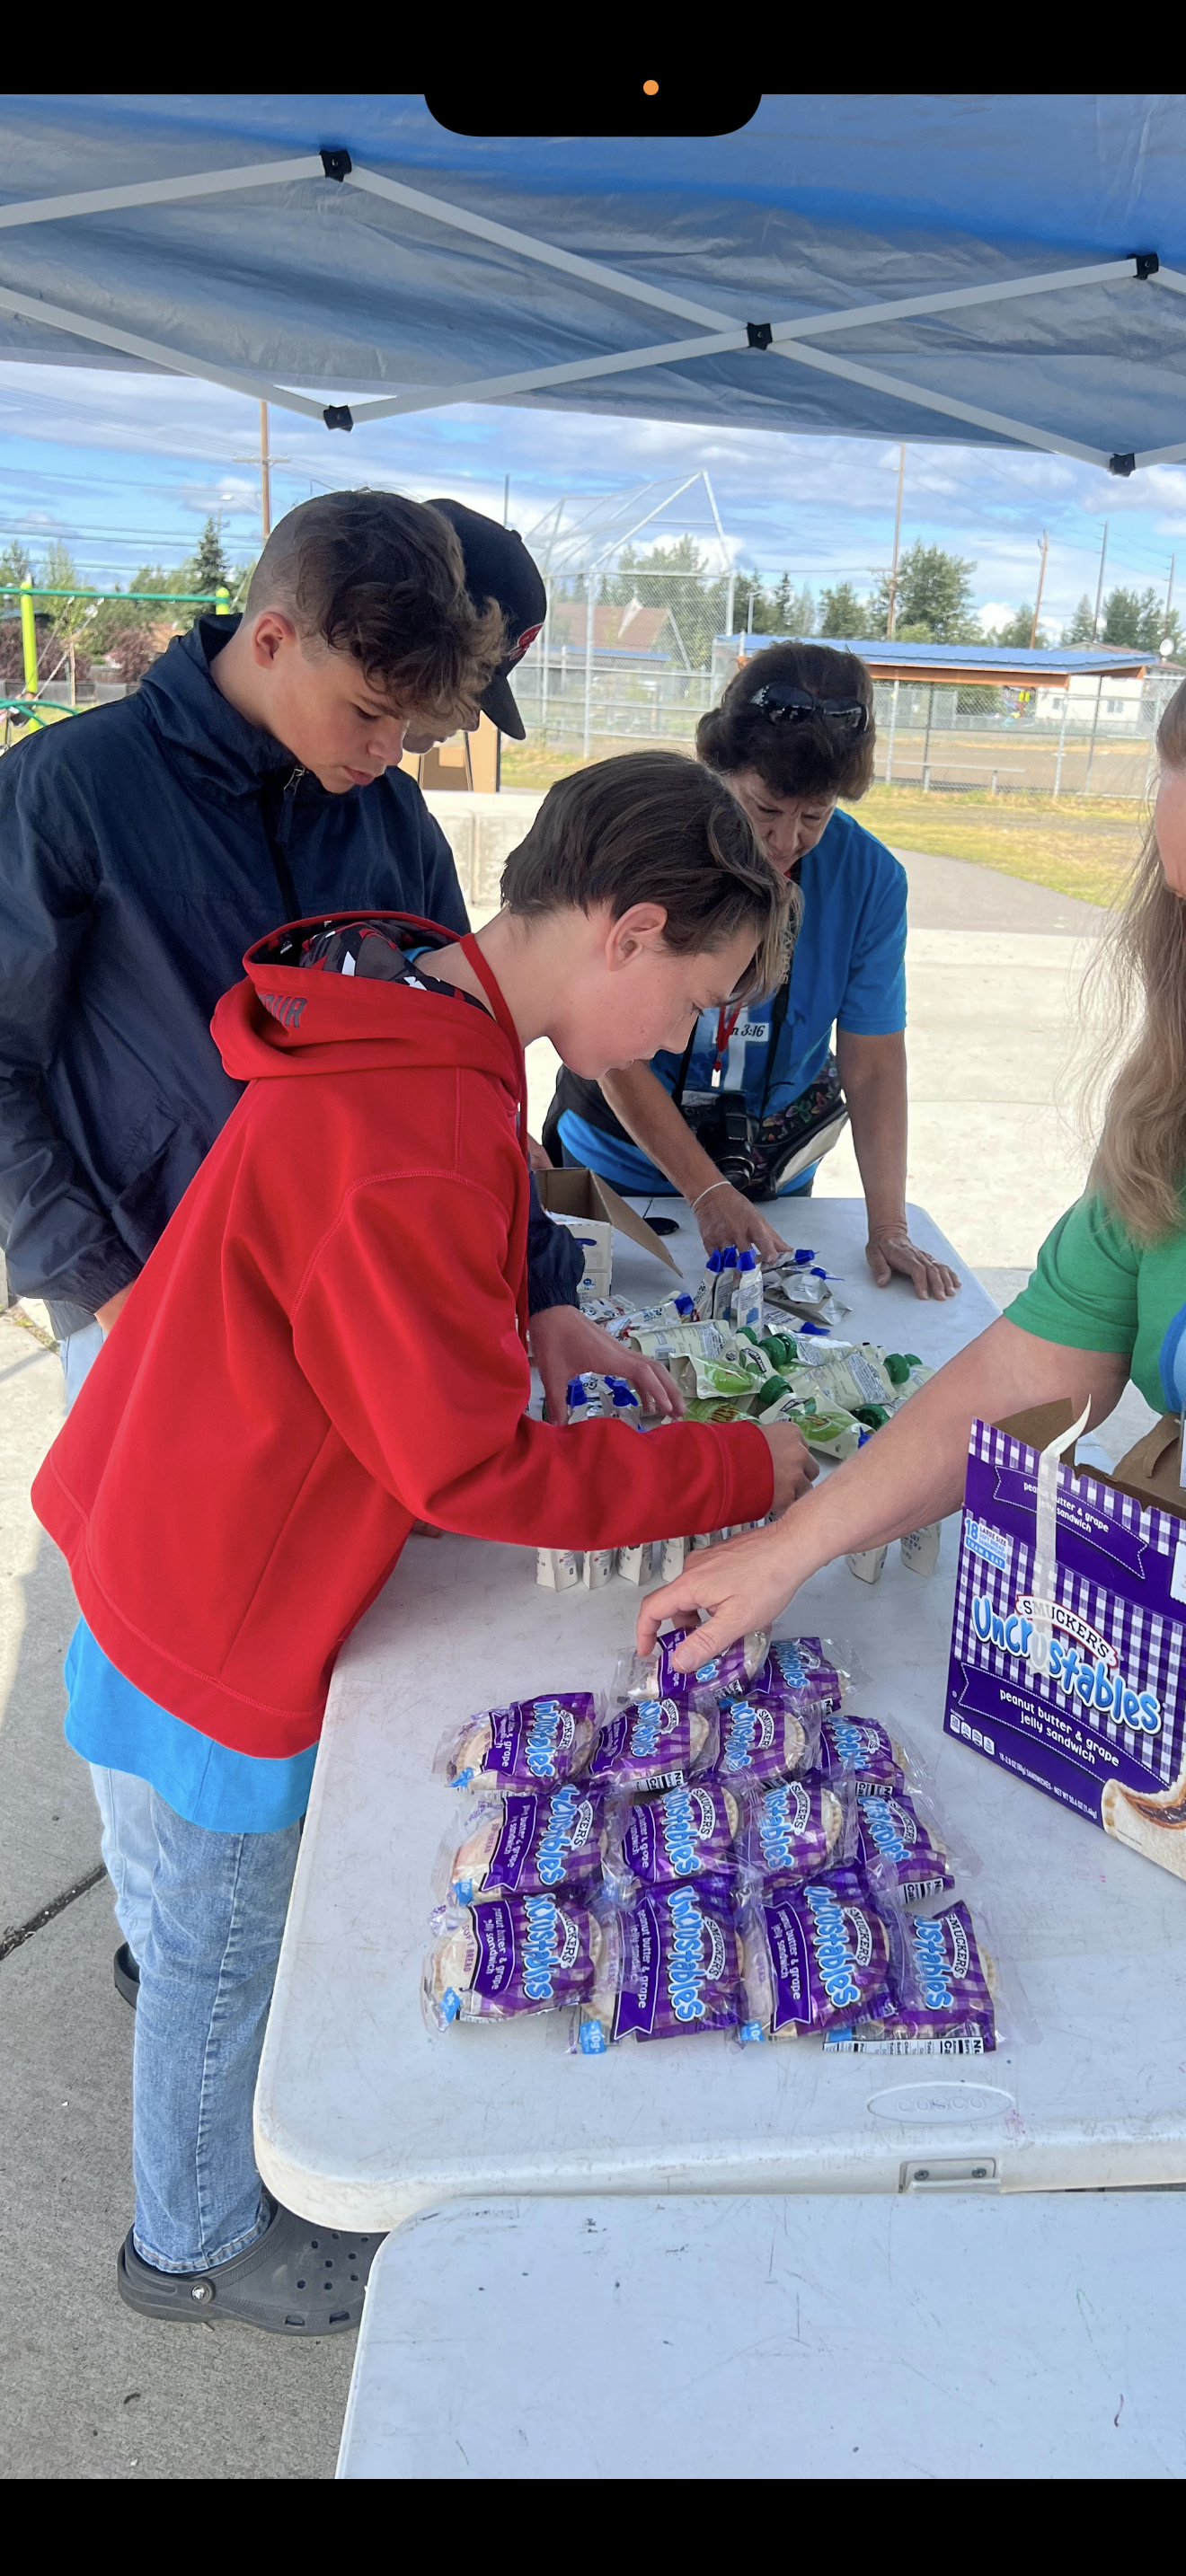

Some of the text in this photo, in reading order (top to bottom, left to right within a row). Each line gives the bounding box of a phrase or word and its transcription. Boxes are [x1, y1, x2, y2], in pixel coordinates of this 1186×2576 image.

[741, 1024, 766, 1037] 3:16
[1023, 1481, 1110, 1533] peanut butter & grape
[1056, 1507, 1092, 1533] sandwich
[965, 1519, 978, 1539] 18
[996, 1535, 1006, 1547] SIZE
[990, 1555, 1003, 1567] EAT
[1022, 1599, 1111, 1659] SMUCKER'S
[973, 1596, 1161, 1734] Uncrustables
[999, 1689, 1120, 1768] peanut butter & grape
[1020, 1710, 1043, 1734] jelly
[1046, 1727, 1096, 1765] sandwich
[501, 1741, 512, 1768] grape
[693, 1789, 713, 1835] SMUCKER'S
[637, 1909, 650, 1936] peanut
[462, 1924, 474, 1973] SOFT BREAD
[486, 1932, 499, 1974] sandwich
[641, 1936, 652, 1963] butter
[668, 1885, 705, 2022] Uncrustables
[706, 1920, 724, 1977] SMUCKER'S
[775, 1940, 790, 1979] sandwich
[784, 1929, 798, 1956] butter
[804, 1886, 861, 2007] Uncrustables
[491, 1965, 505, 1990] grape
[638, 1975, 650, 2009] grape
[789, 1966, 801, 2000] grape
[898, 2095, 986, 2113] COSCO
